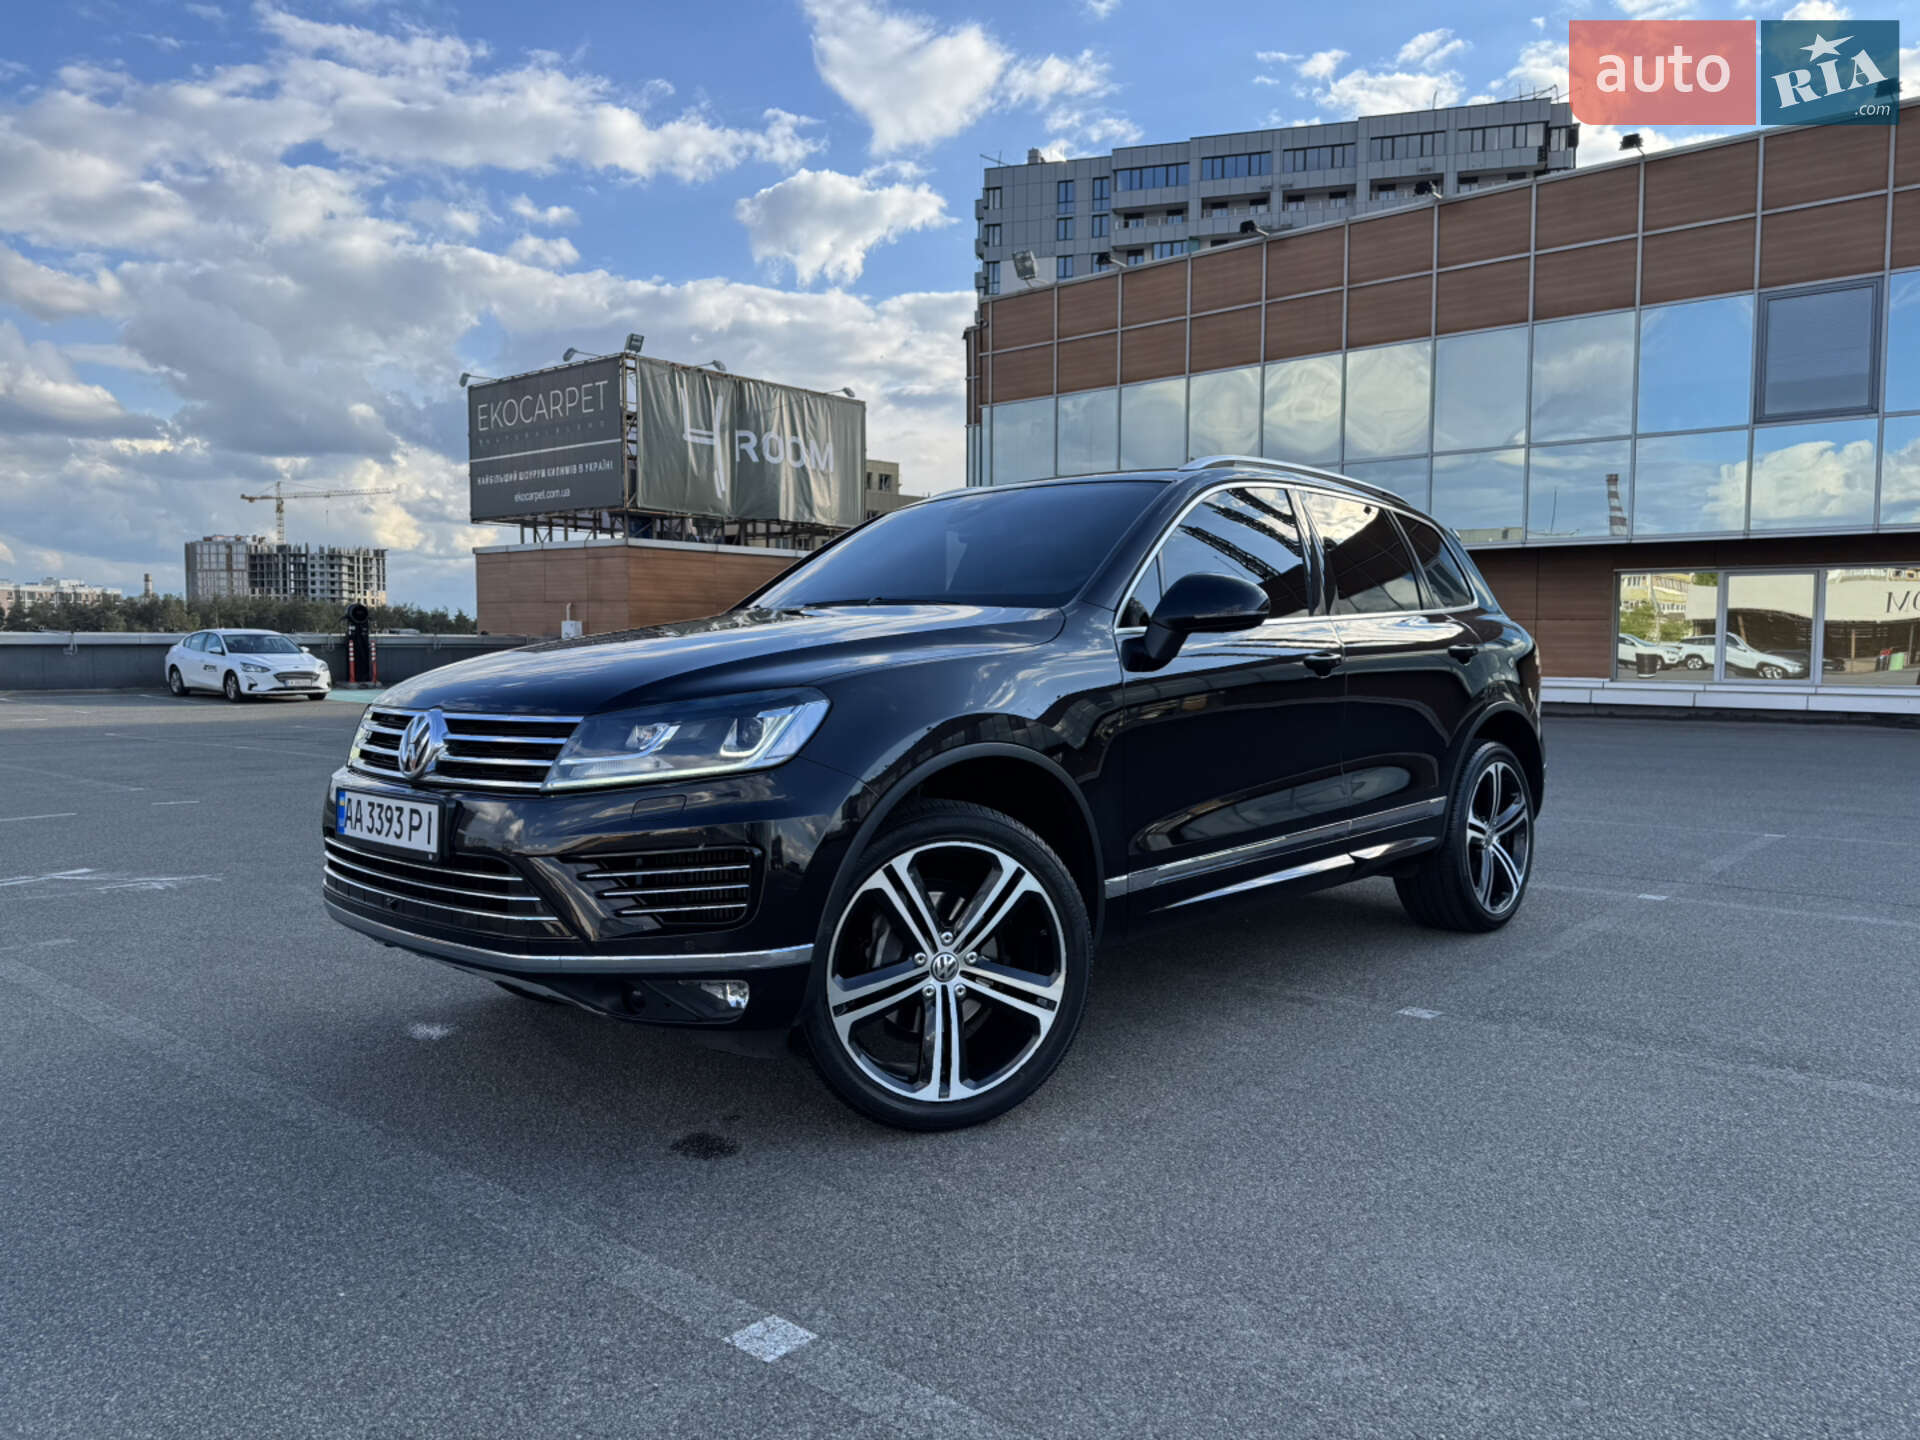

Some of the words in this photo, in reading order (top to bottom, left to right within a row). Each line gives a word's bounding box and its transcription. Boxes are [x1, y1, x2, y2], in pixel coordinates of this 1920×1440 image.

[477, 380, 608, 431] EKOCARPET
[344, 797, 363, 832] AA
[366, 801, 404, 839] 3393
